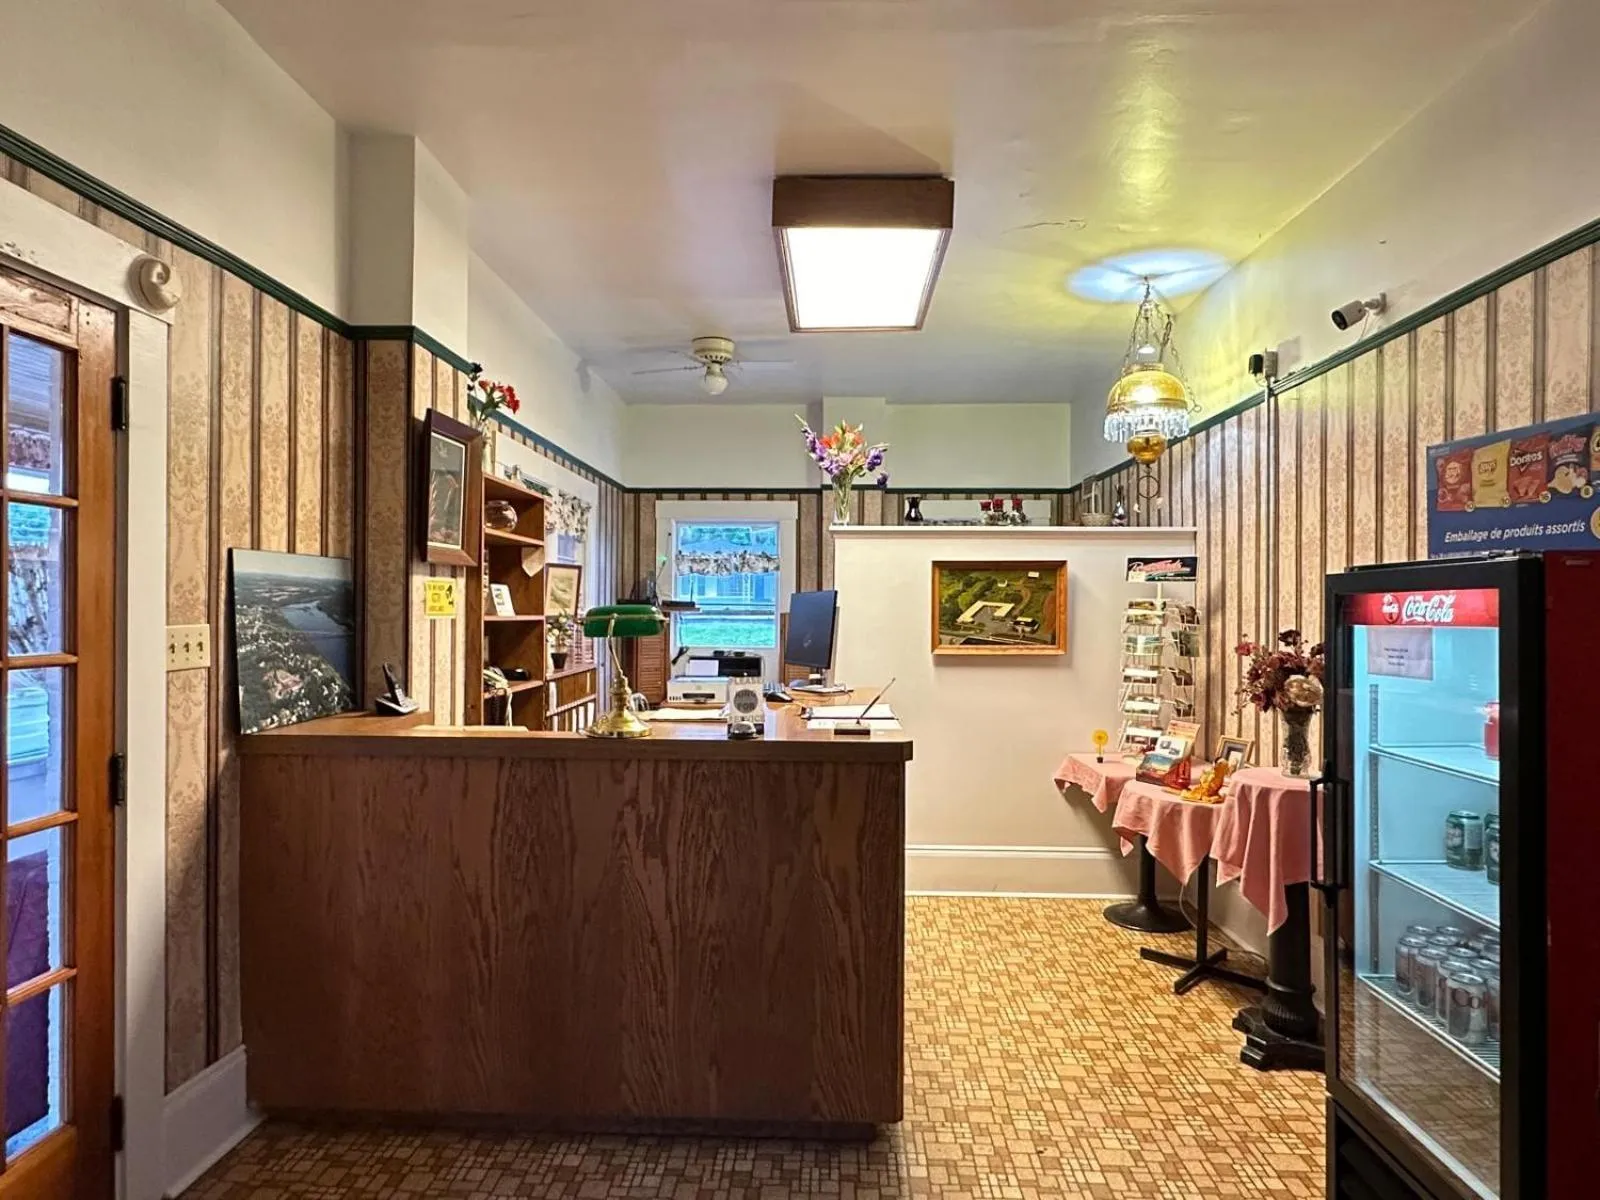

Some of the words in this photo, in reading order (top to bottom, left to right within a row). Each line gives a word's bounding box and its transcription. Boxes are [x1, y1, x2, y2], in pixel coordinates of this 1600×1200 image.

[1510, 451, 1543, 467] Doritos
[1444, 530, 1488, 543] Emballage
[1490, 527, 1502, 539] de
[1503, 524, 1544, 540] produits
[1545, 519, 1586, 535] assortis
